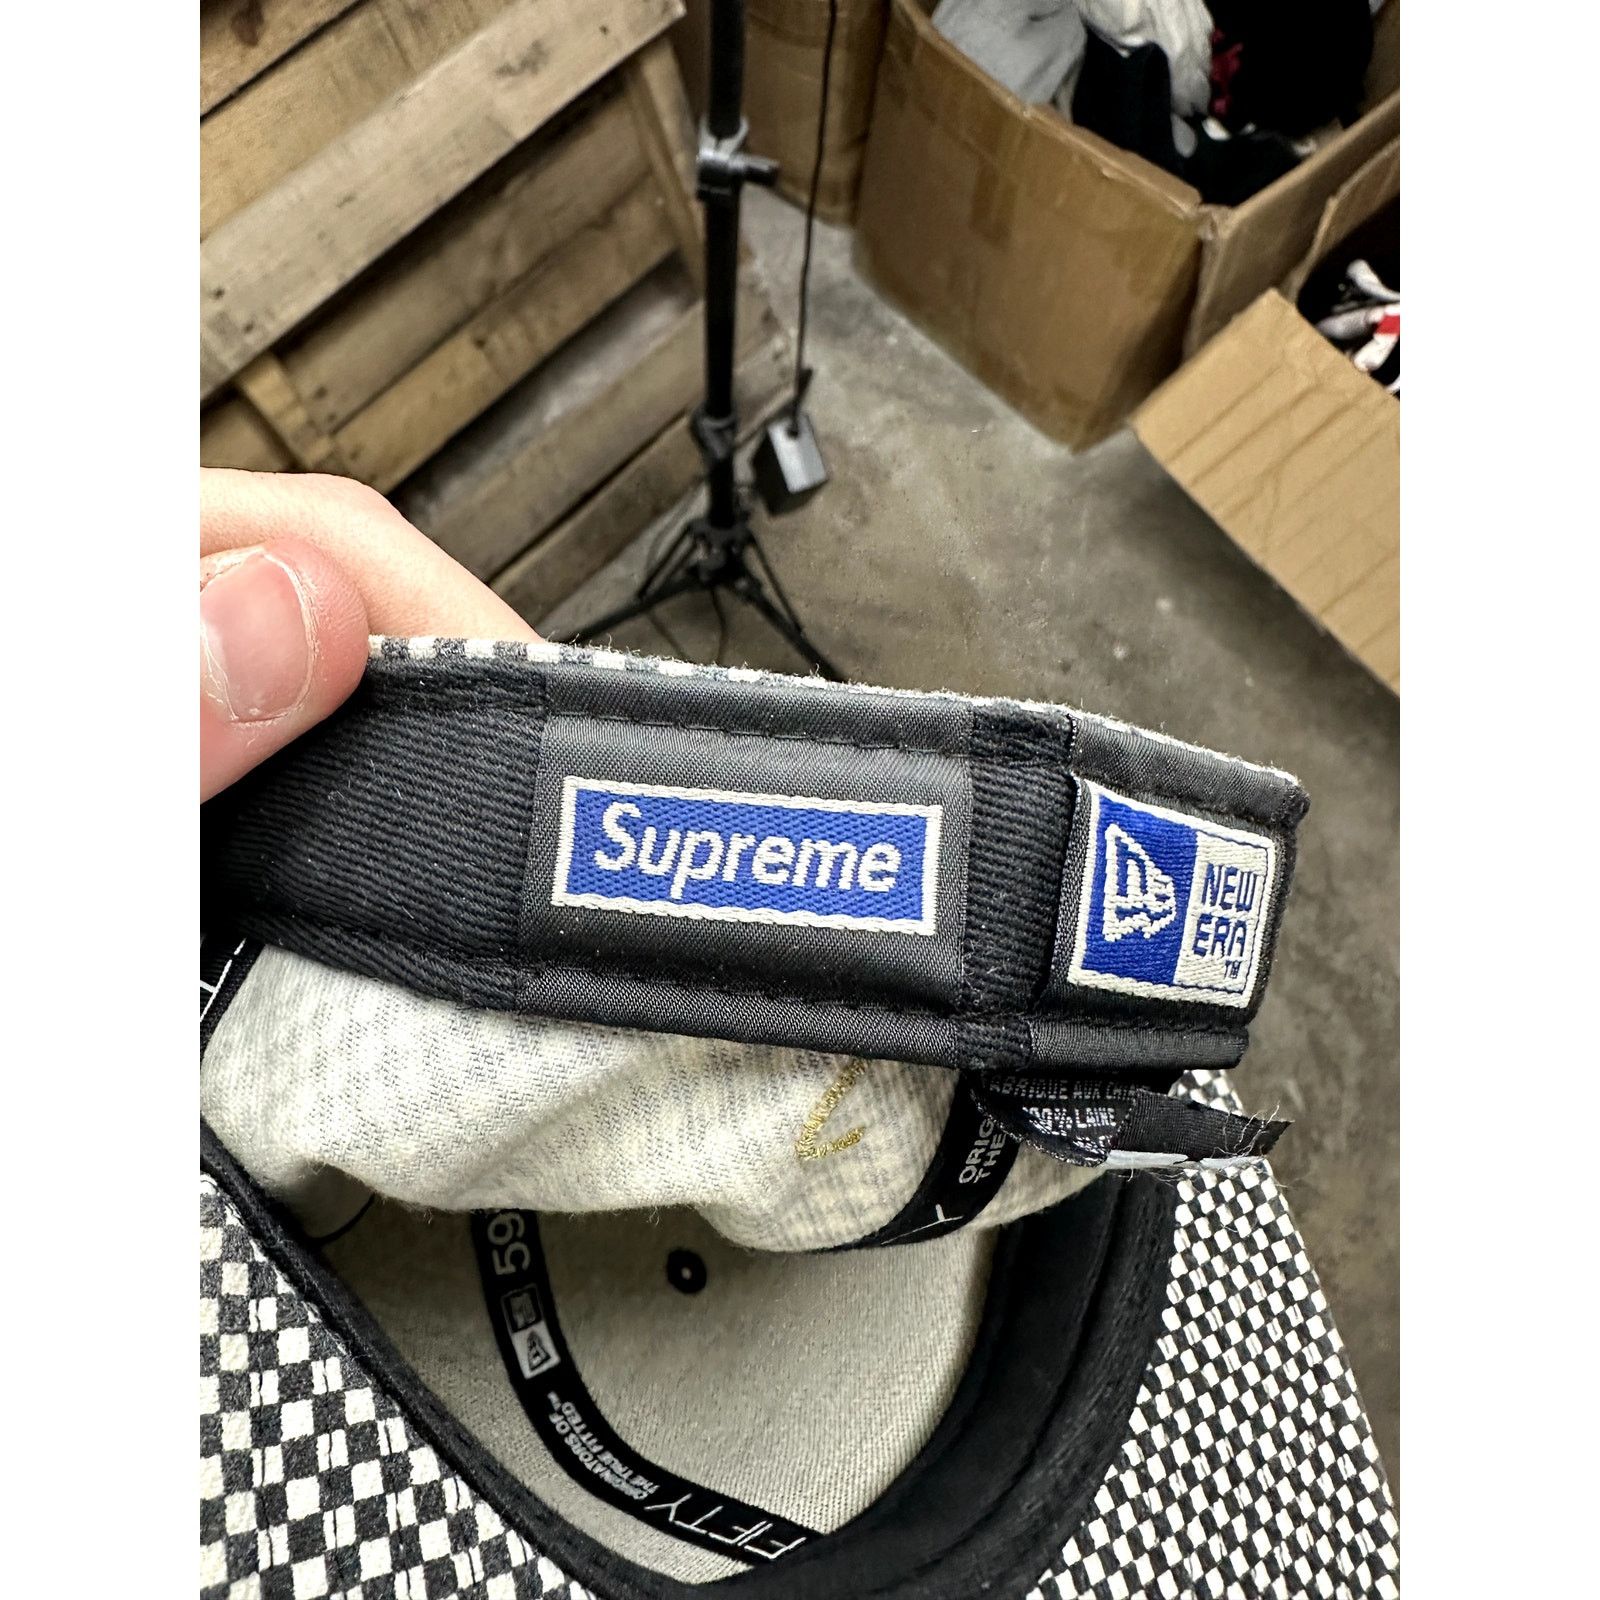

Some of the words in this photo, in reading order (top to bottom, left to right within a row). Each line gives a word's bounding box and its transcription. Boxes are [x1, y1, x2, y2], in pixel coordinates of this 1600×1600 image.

[594, 801, 902, 899] Supreme
[1201, 862, 1258, 912] NEW
[1192, 912, 1247, 958] ERA
[1074, 1106, 1117, 1129] LAINE
[972, 1132, 1008, 1184] THE
[487, 1211, 531, 1275] 59
[548, 1411, 572, 1436] OF
